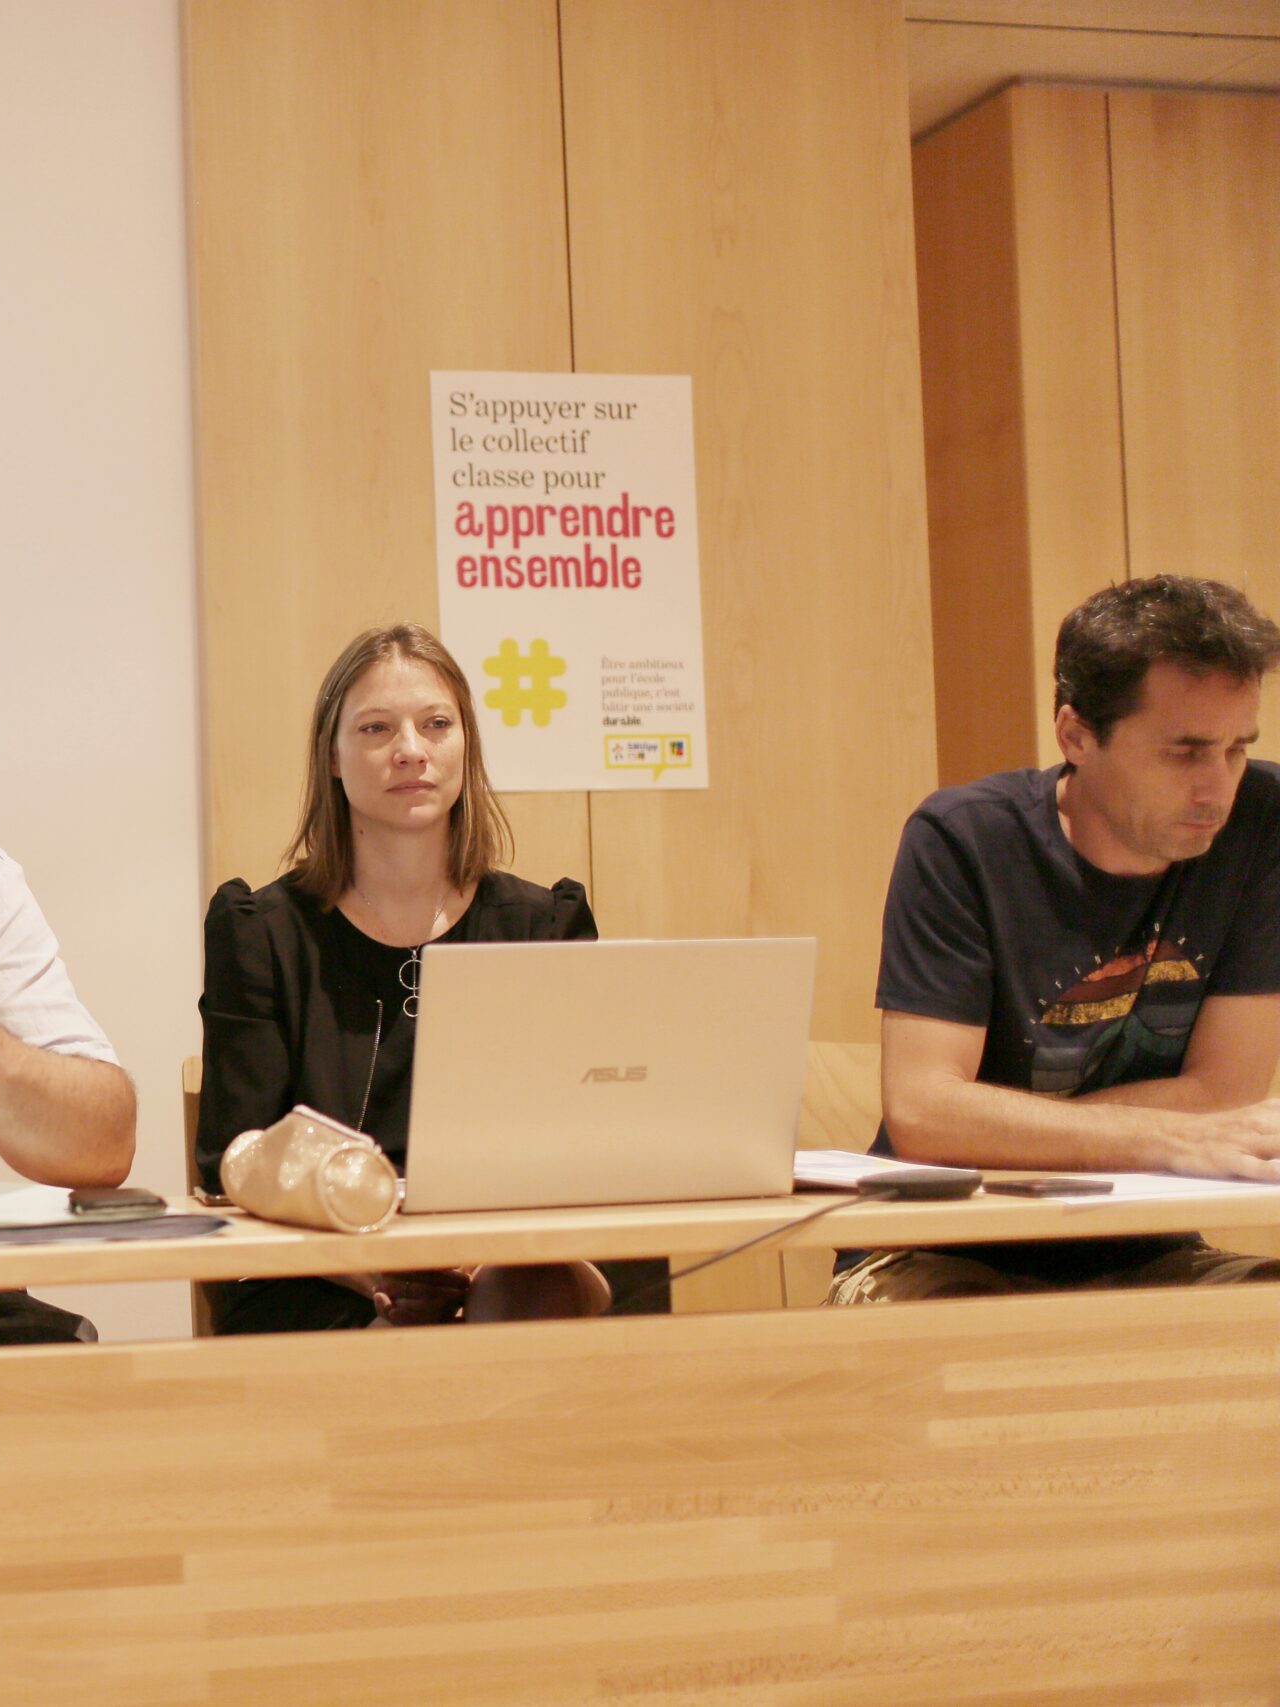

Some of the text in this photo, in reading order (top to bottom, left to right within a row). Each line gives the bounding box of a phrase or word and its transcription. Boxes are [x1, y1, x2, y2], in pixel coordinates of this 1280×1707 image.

[449, 391, 637, 424] S'appuyer sur
[451, 427, 590, 454] le collectif
[452, 462, 606, 495] classe pour
[455, 492, 675, 549] apprendre
[457, 543, 641, 589] ensemble
[629, 658, 685, 670] ambitieux
[601, 675, 627, 687] pour
[632, 703, 653, 712] une
[581, 1066, 648, 1083] ASUS
